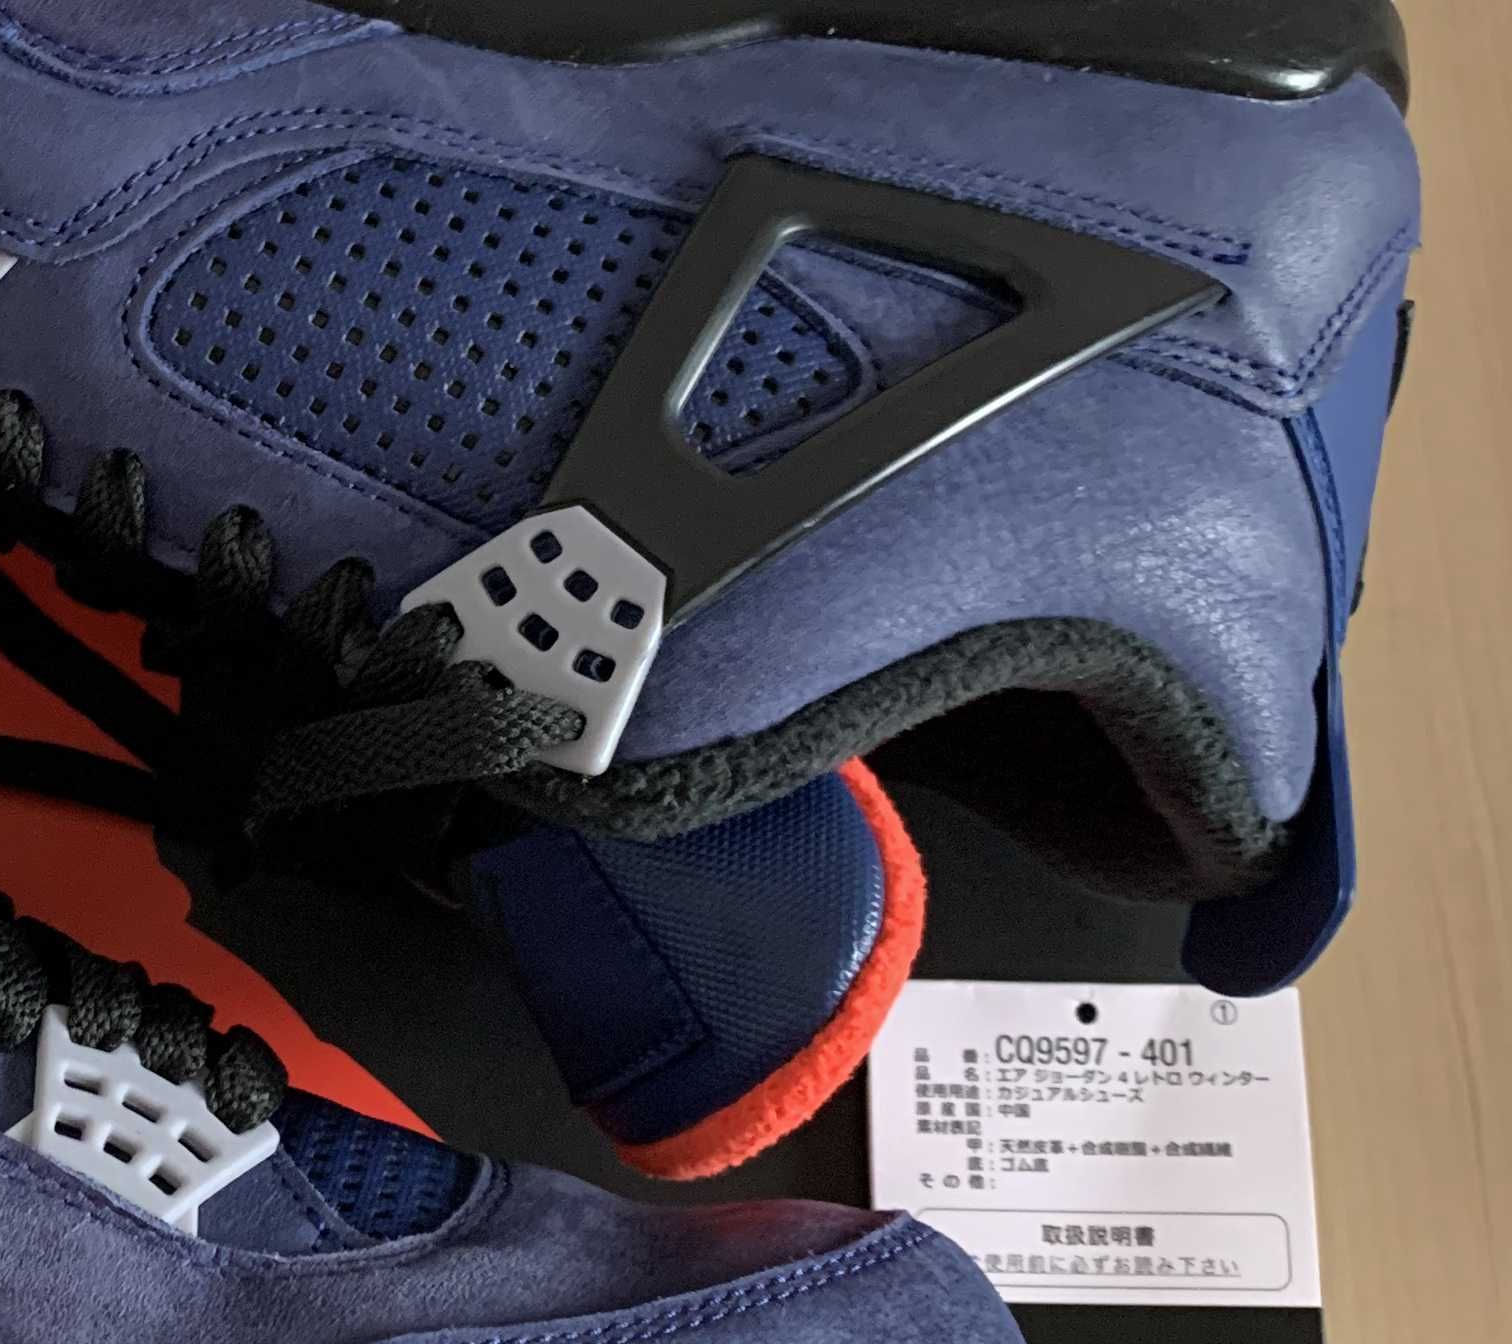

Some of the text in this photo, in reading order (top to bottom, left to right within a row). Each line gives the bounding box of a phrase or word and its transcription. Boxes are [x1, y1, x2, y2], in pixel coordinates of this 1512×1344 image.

[995, 1034, 1108, 1066] CQ9597
[1141, 1037, 1193, 1067] 401
[1041, 1224, 1155, 1247] 取扱説明書
[970, 1254, 1241, 1276] 使用前に必ずお読み下さい
